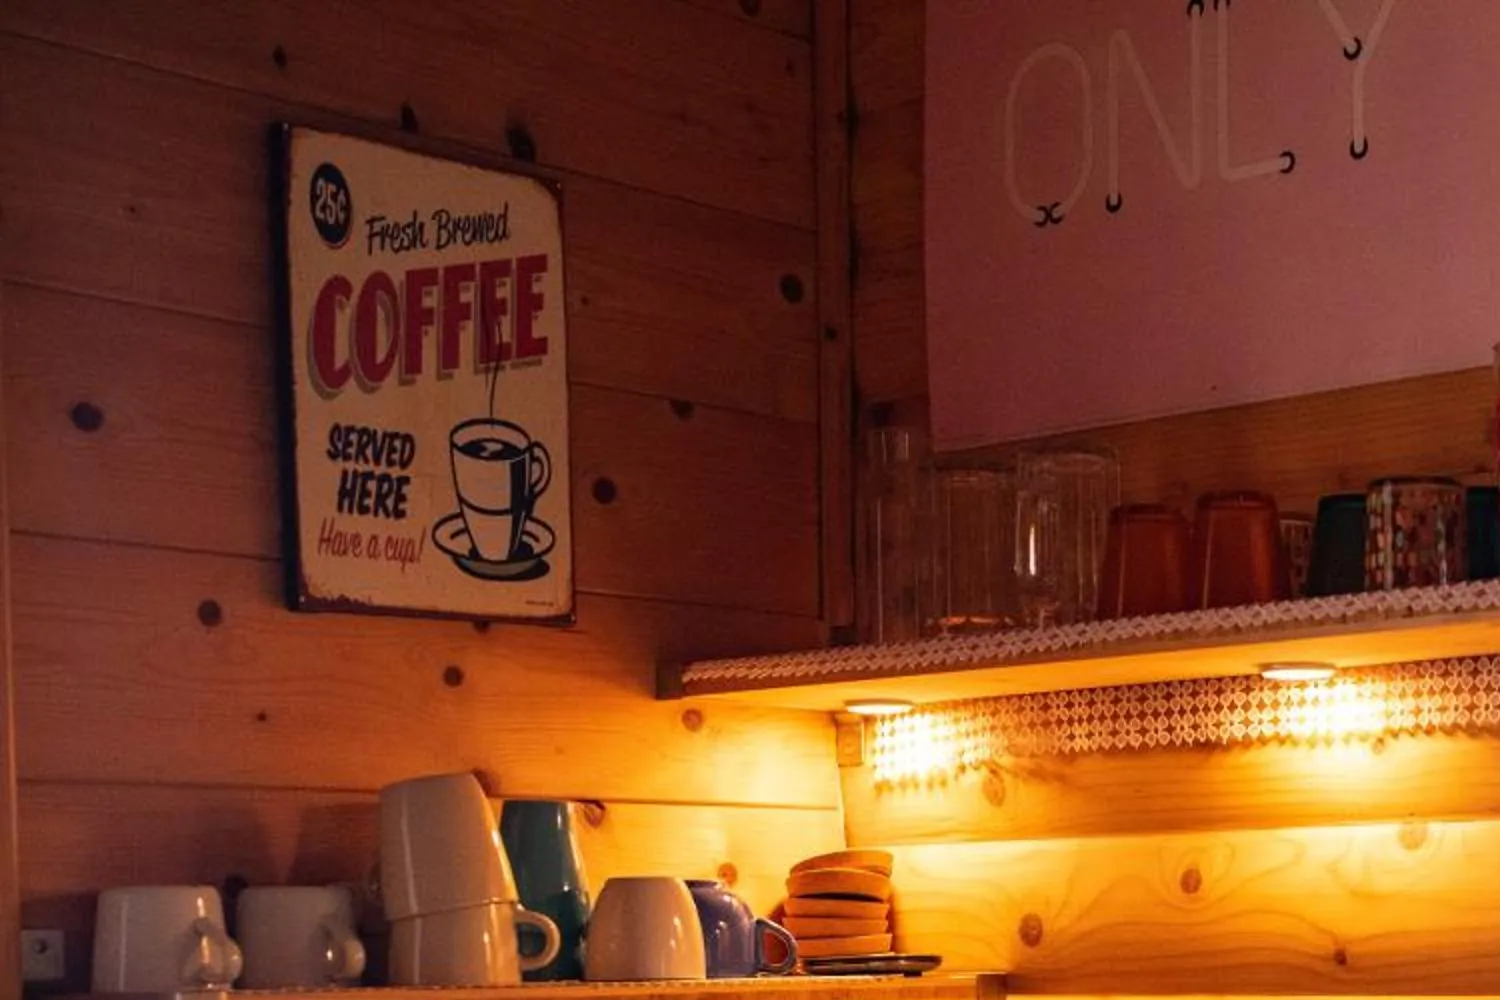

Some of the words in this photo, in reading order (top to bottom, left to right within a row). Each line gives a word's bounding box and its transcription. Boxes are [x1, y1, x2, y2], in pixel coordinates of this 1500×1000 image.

[1004, 0, 1394, 222] ONLY
[366, 210, 429, 255] Fresh
[431, 202, 511, 250] Brewed
[309, 253, 549, 393] COFFEE
[326, 422, 416, 469] SERVED
[337, 468, 411, 520] HERE
[317, 518, 363, 558] Have
[366, 536, 379, 558] a
[384, 527, 427, 574] cup!
